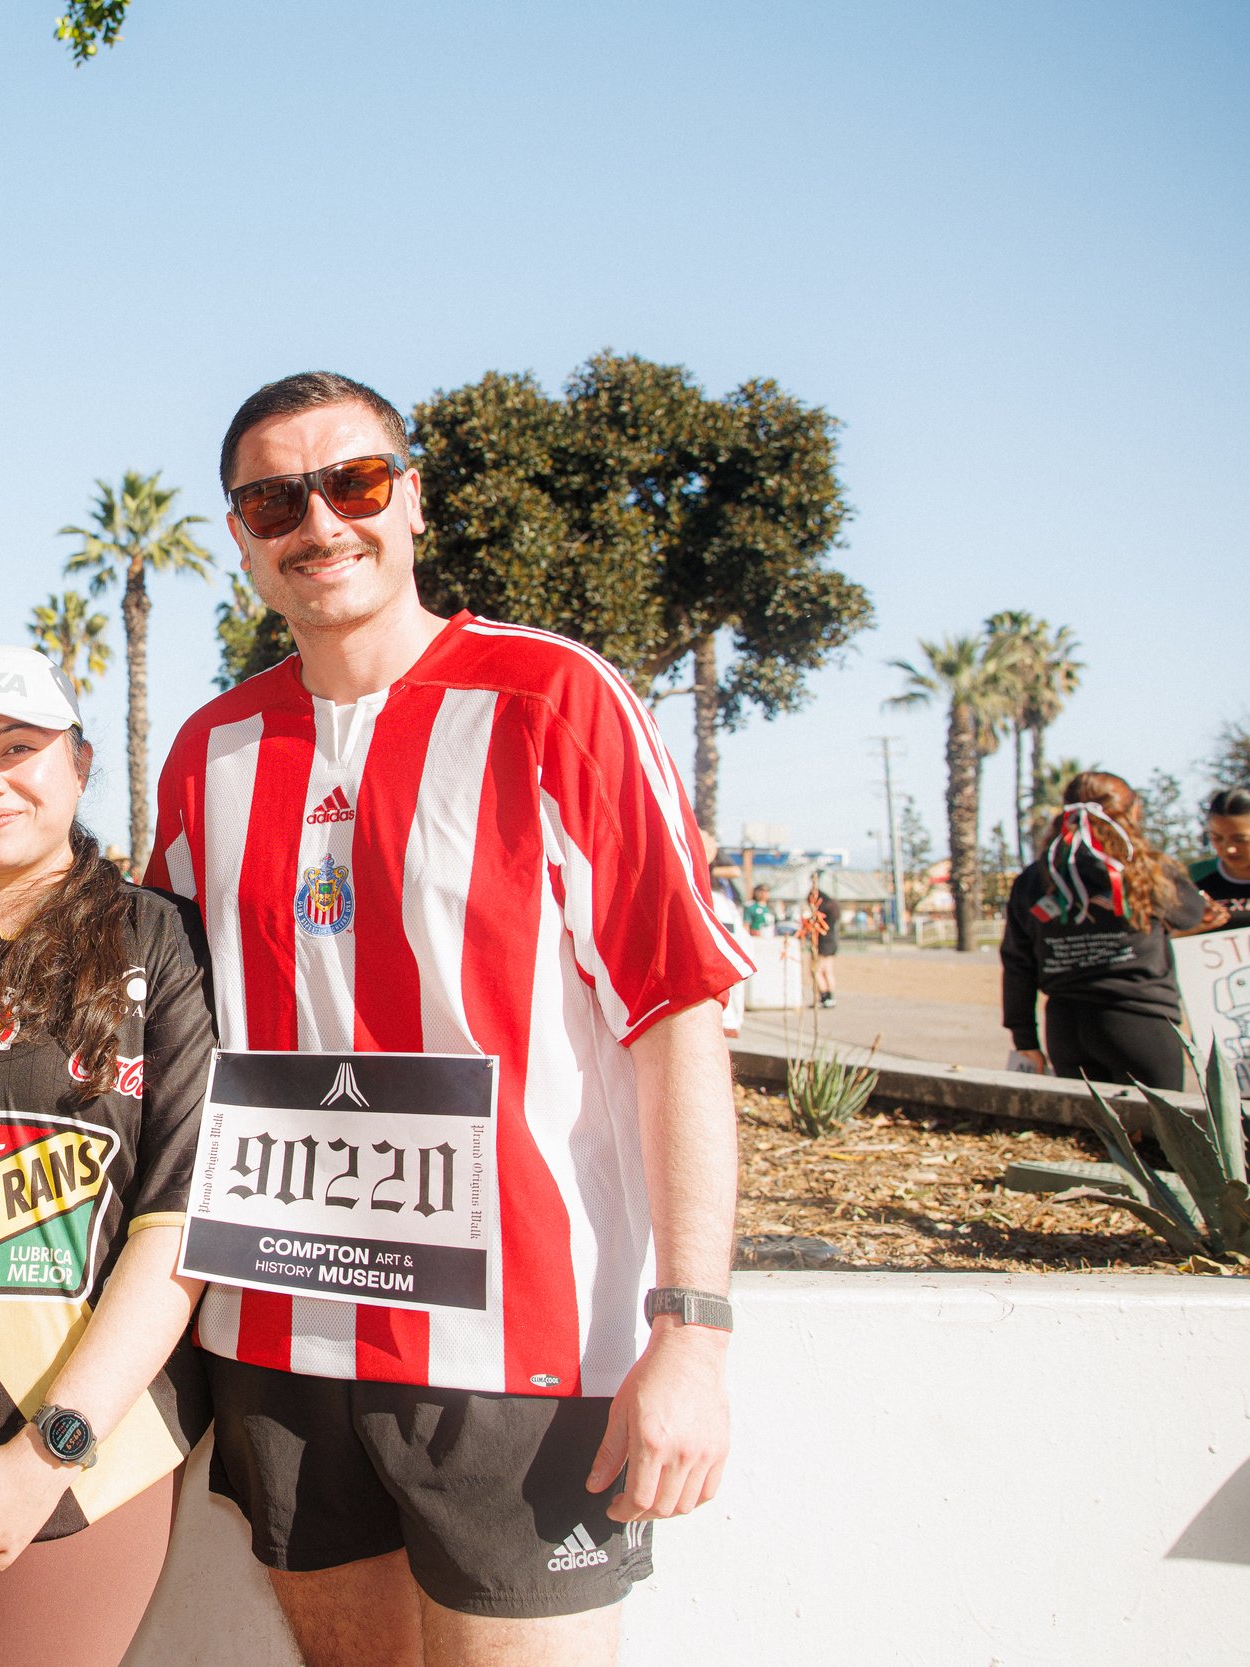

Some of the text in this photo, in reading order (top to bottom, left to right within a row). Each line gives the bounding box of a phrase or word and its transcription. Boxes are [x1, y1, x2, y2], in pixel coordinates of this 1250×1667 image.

[306, 809, 355, 824] adidas
[197, 1112, 224, 1213] Proud Origins Walk
[226, 1131, 458, 1218] 90220
[470, 1124, 484, 1240] Proud Origins Walk
[9, 1245, 72, 1266] LUBRICA
[258, 1237, 414, 1267] COMPTON ART &
[6, 1263, 73, 1285] MEJOR
[255, 1260, 414, 1292] HISTORY MUSEUM
[547, 1548, 609, 1572] adidas
